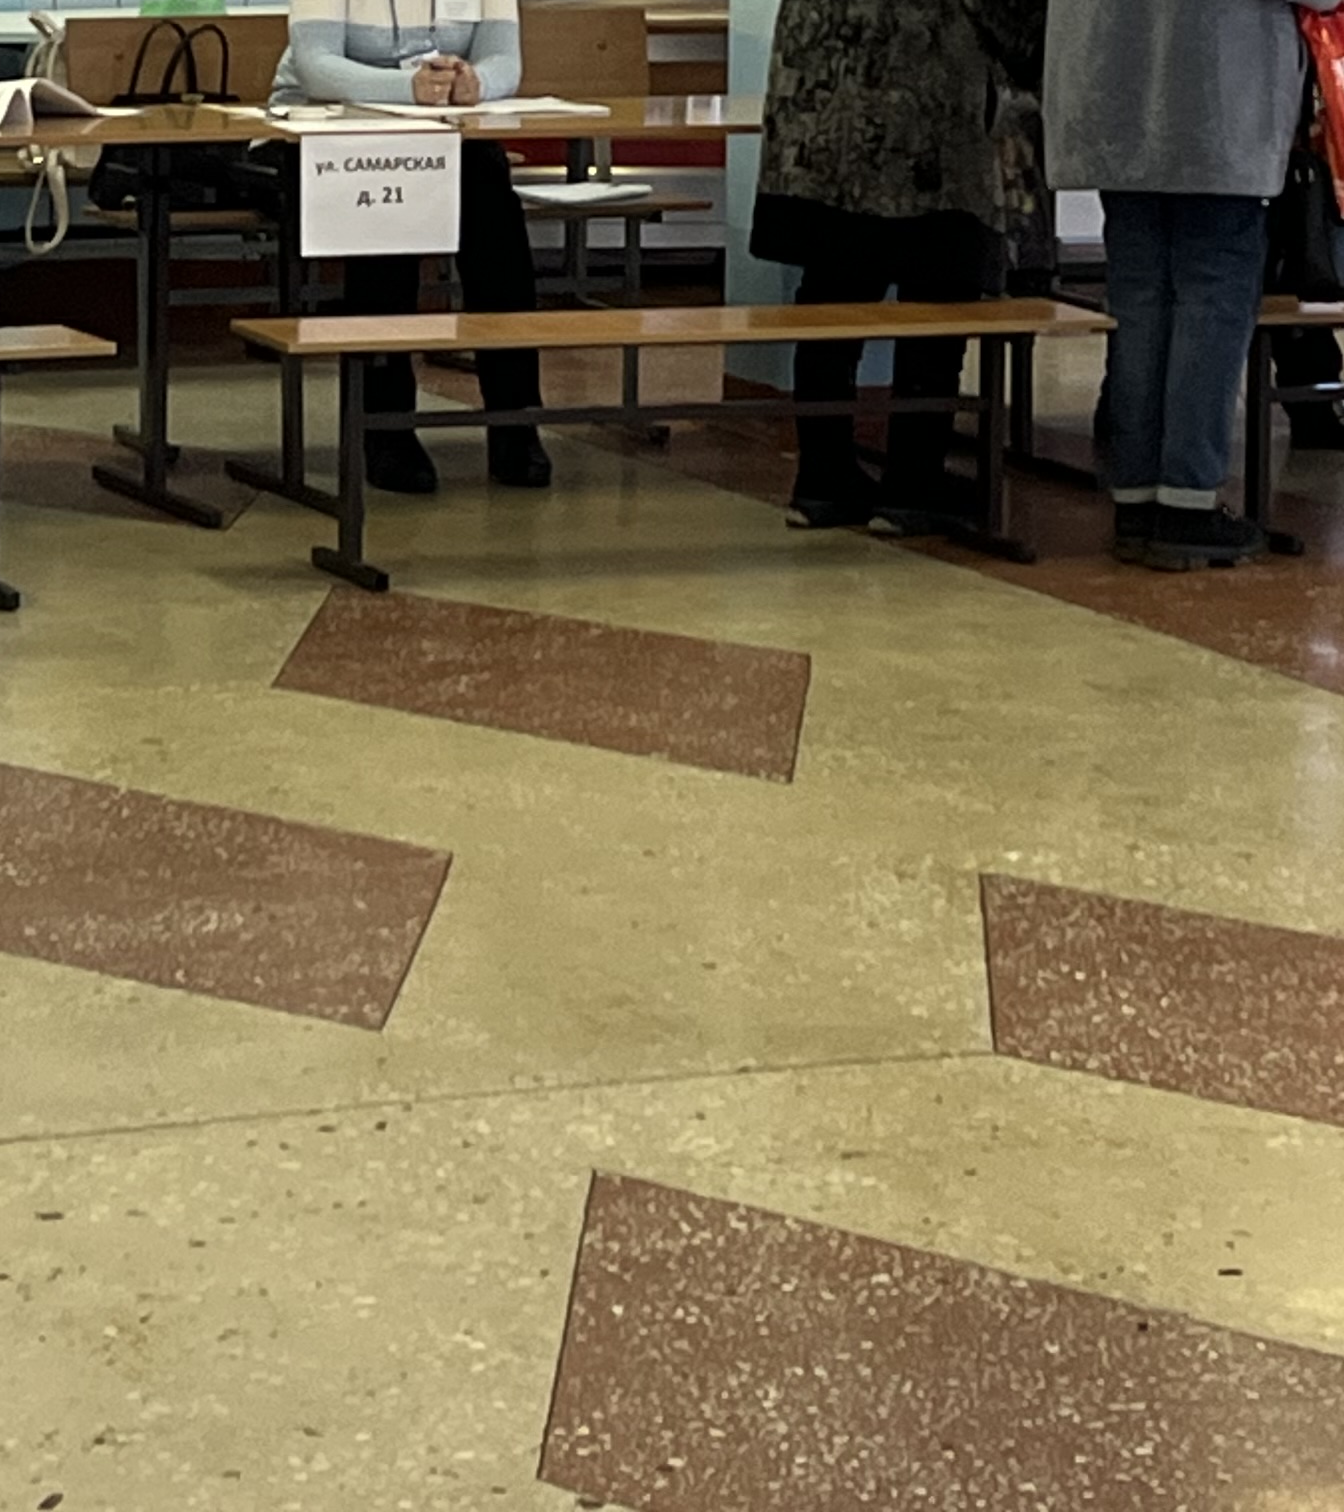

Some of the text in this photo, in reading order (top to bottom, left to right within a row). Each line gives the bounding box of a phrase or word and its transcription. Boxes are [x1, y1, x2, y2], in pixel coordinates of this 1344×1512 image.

[315, 155, 446, 176] ул. САМАРСКАЯ
[356, 186, 404, 207] д. 21
